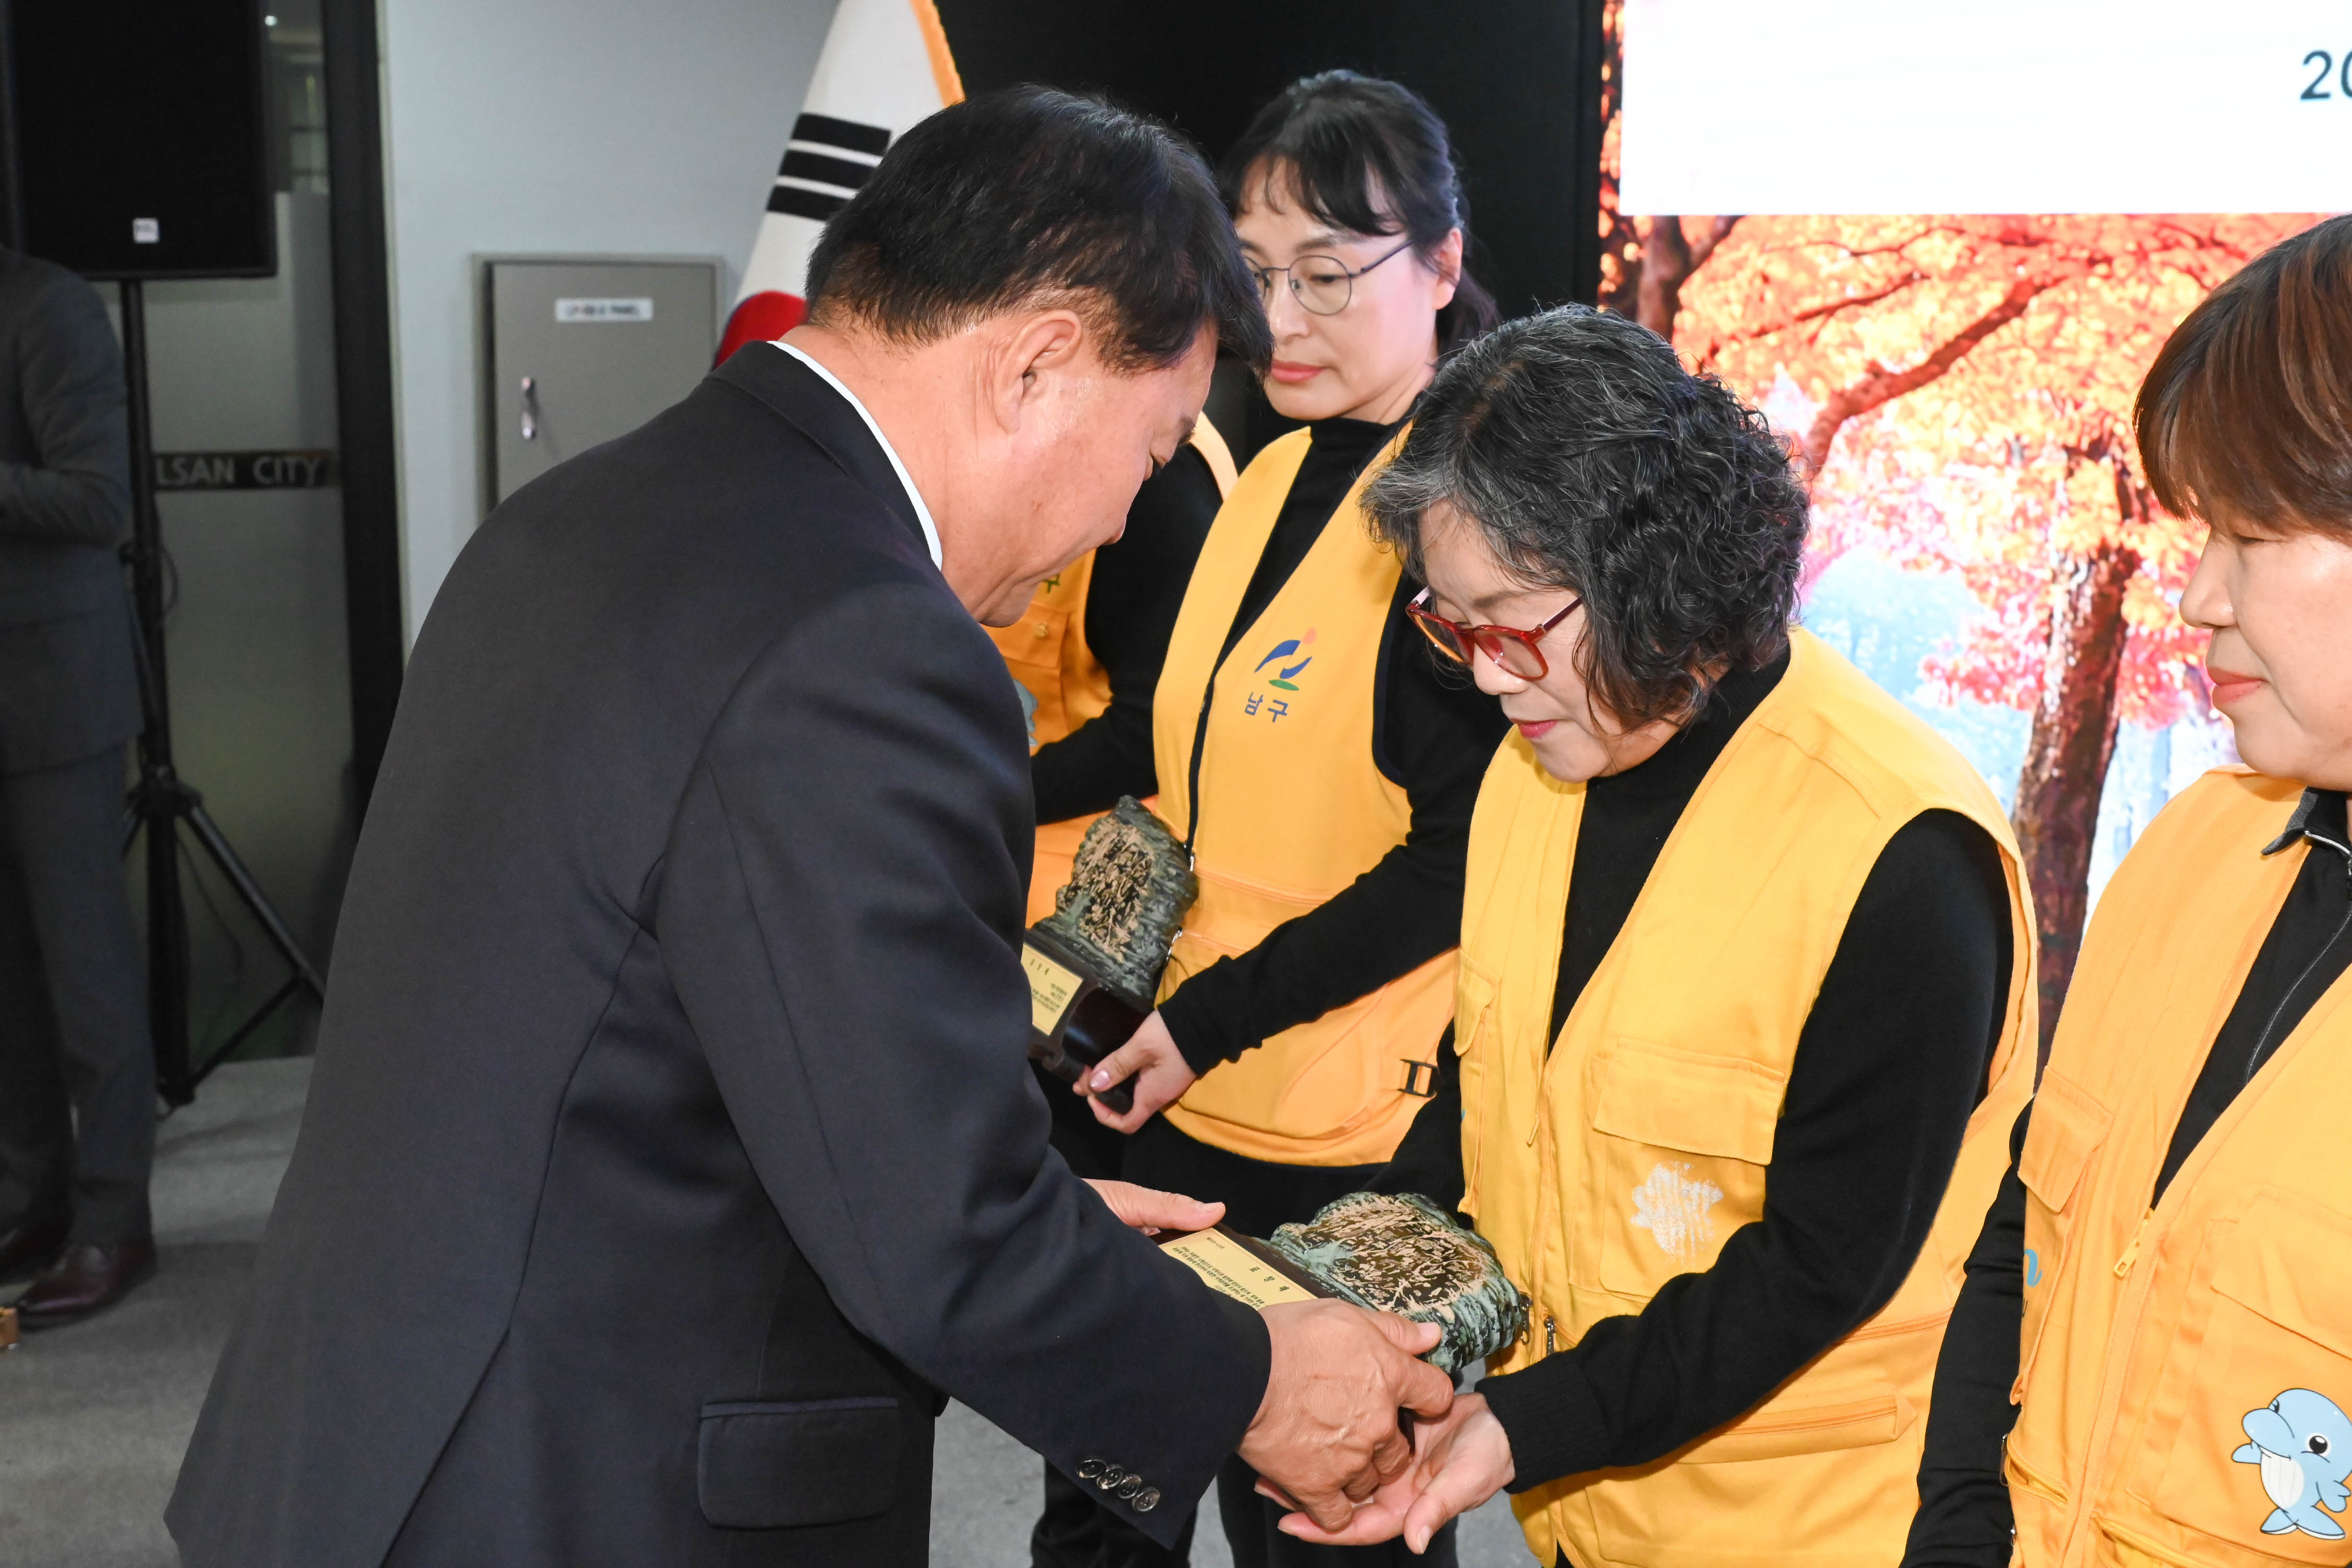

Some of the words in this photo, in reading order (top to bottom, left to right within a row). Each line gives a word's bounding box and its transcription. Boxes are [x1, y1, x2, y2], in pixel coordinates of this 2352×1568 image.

[156, 456, 236, 486] LSAN
[252, 456, 324, 488] CITY
[1244, 692, 1289, 722] 남구
